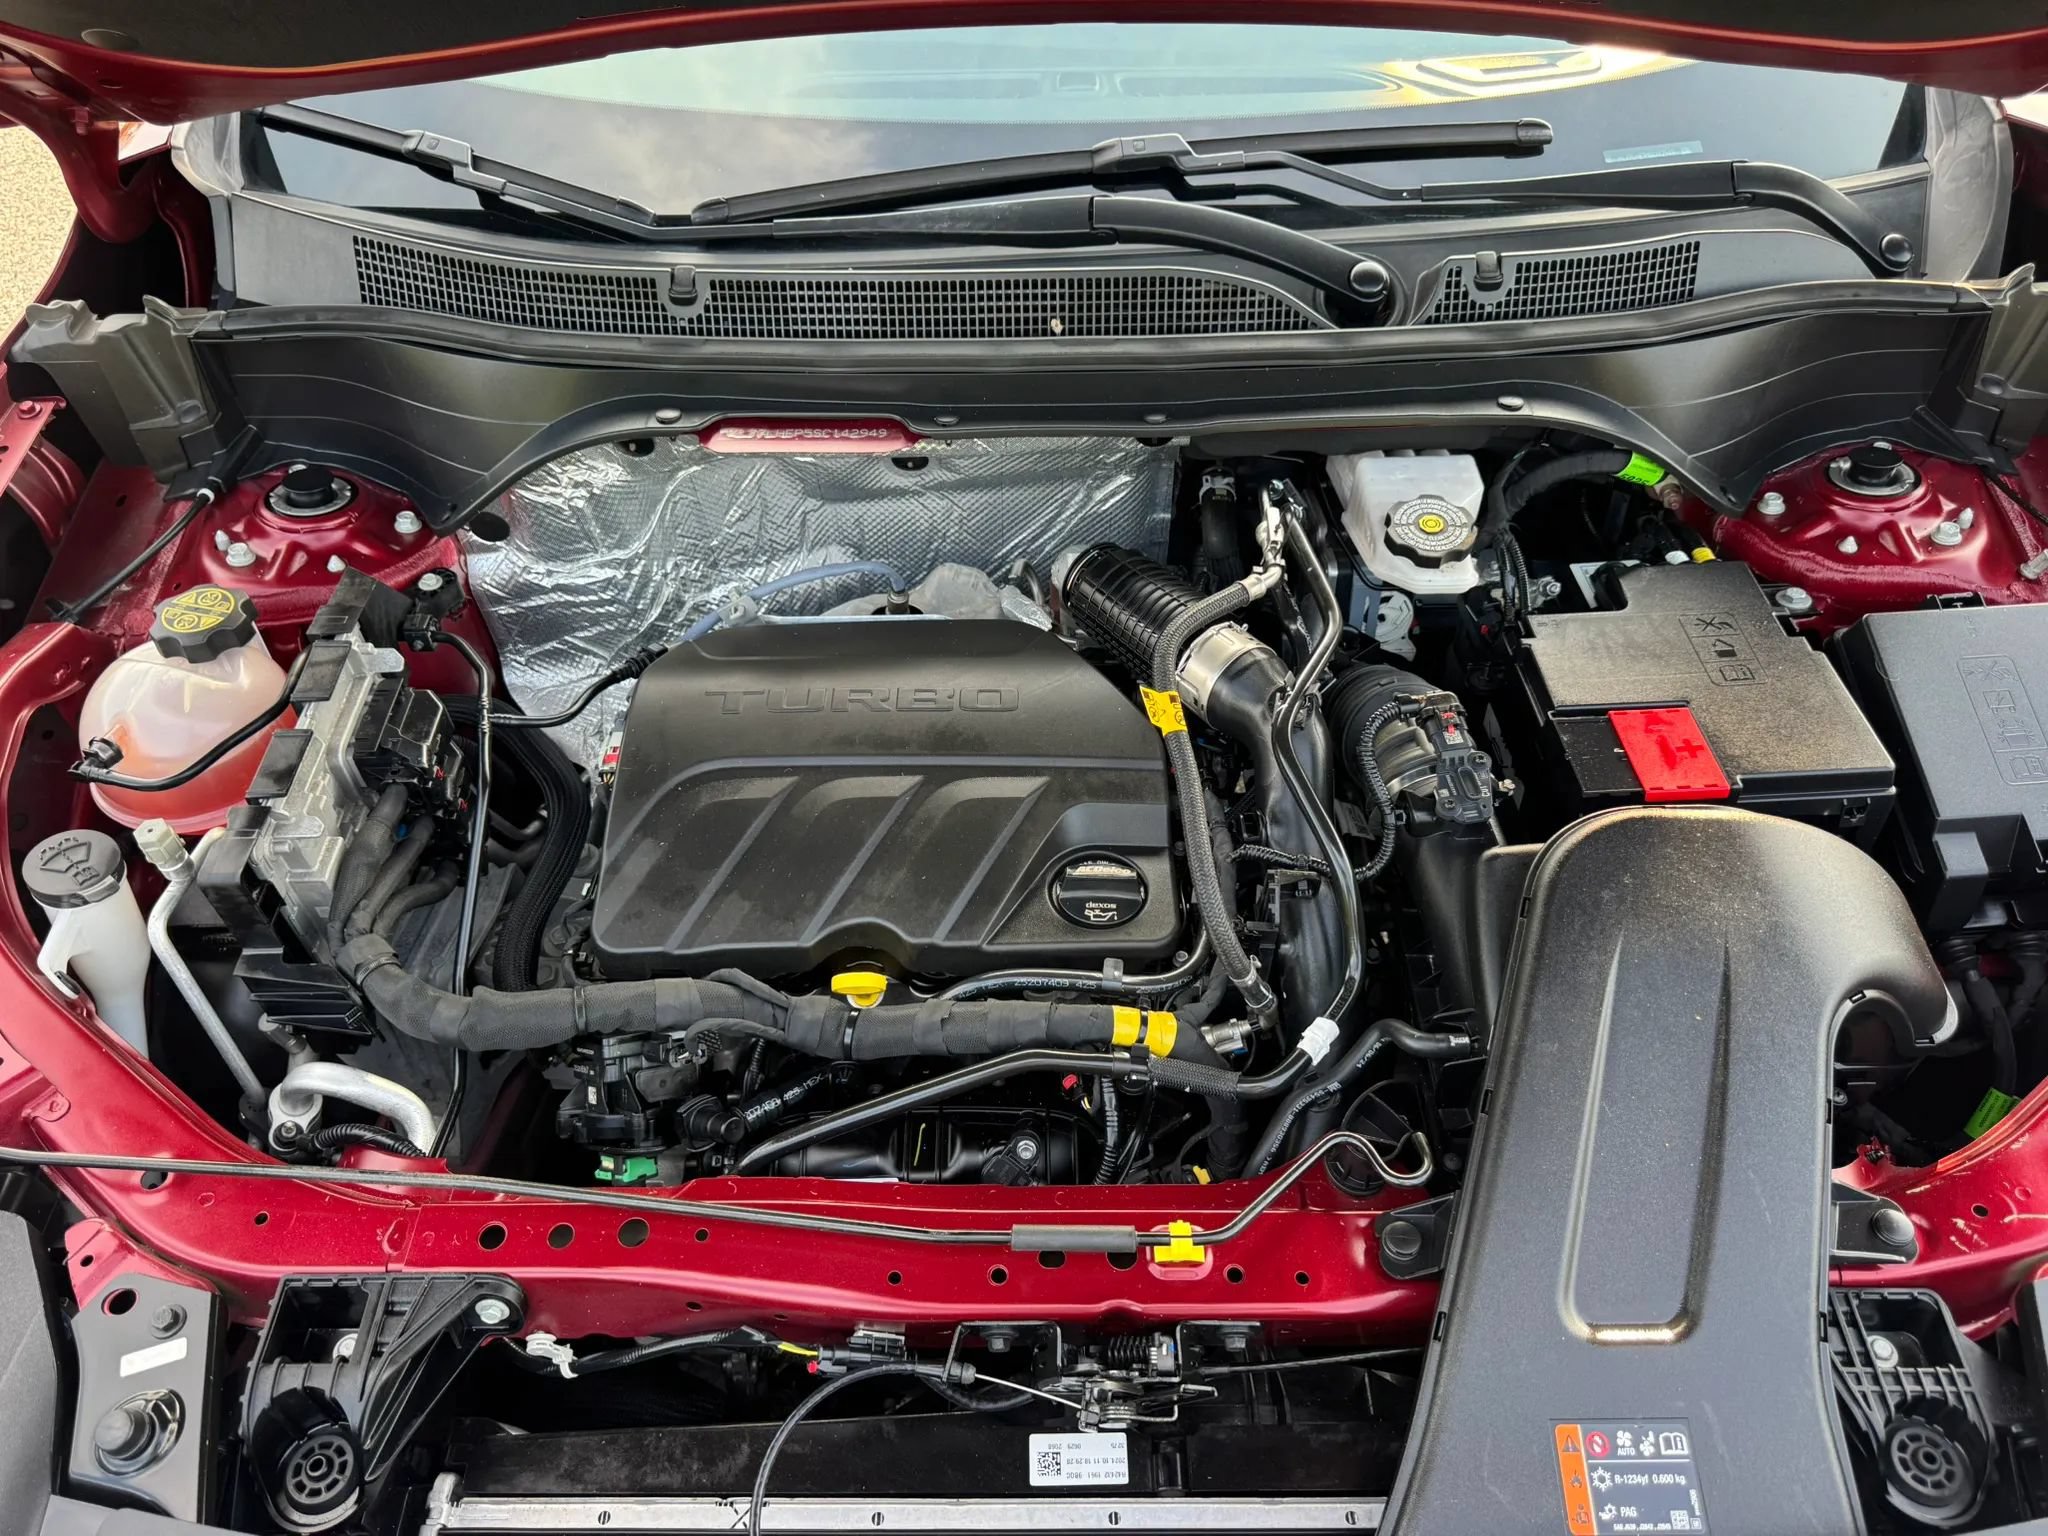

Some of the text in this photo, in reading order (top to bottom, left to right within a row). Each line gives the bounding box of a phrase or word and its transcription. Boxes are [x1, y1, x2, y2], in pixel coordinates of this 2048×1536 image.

[704, 687, 1019, 714] TURBO
[1085, 901, 1117, 909] dexos
[1076, 980, 1097, 990] 425
[1617, 1447, 1635, 1456] AUTO
[1674, 1474, 1686, 1486] kg
[1620, 1506, 1637, 1517] PAG
